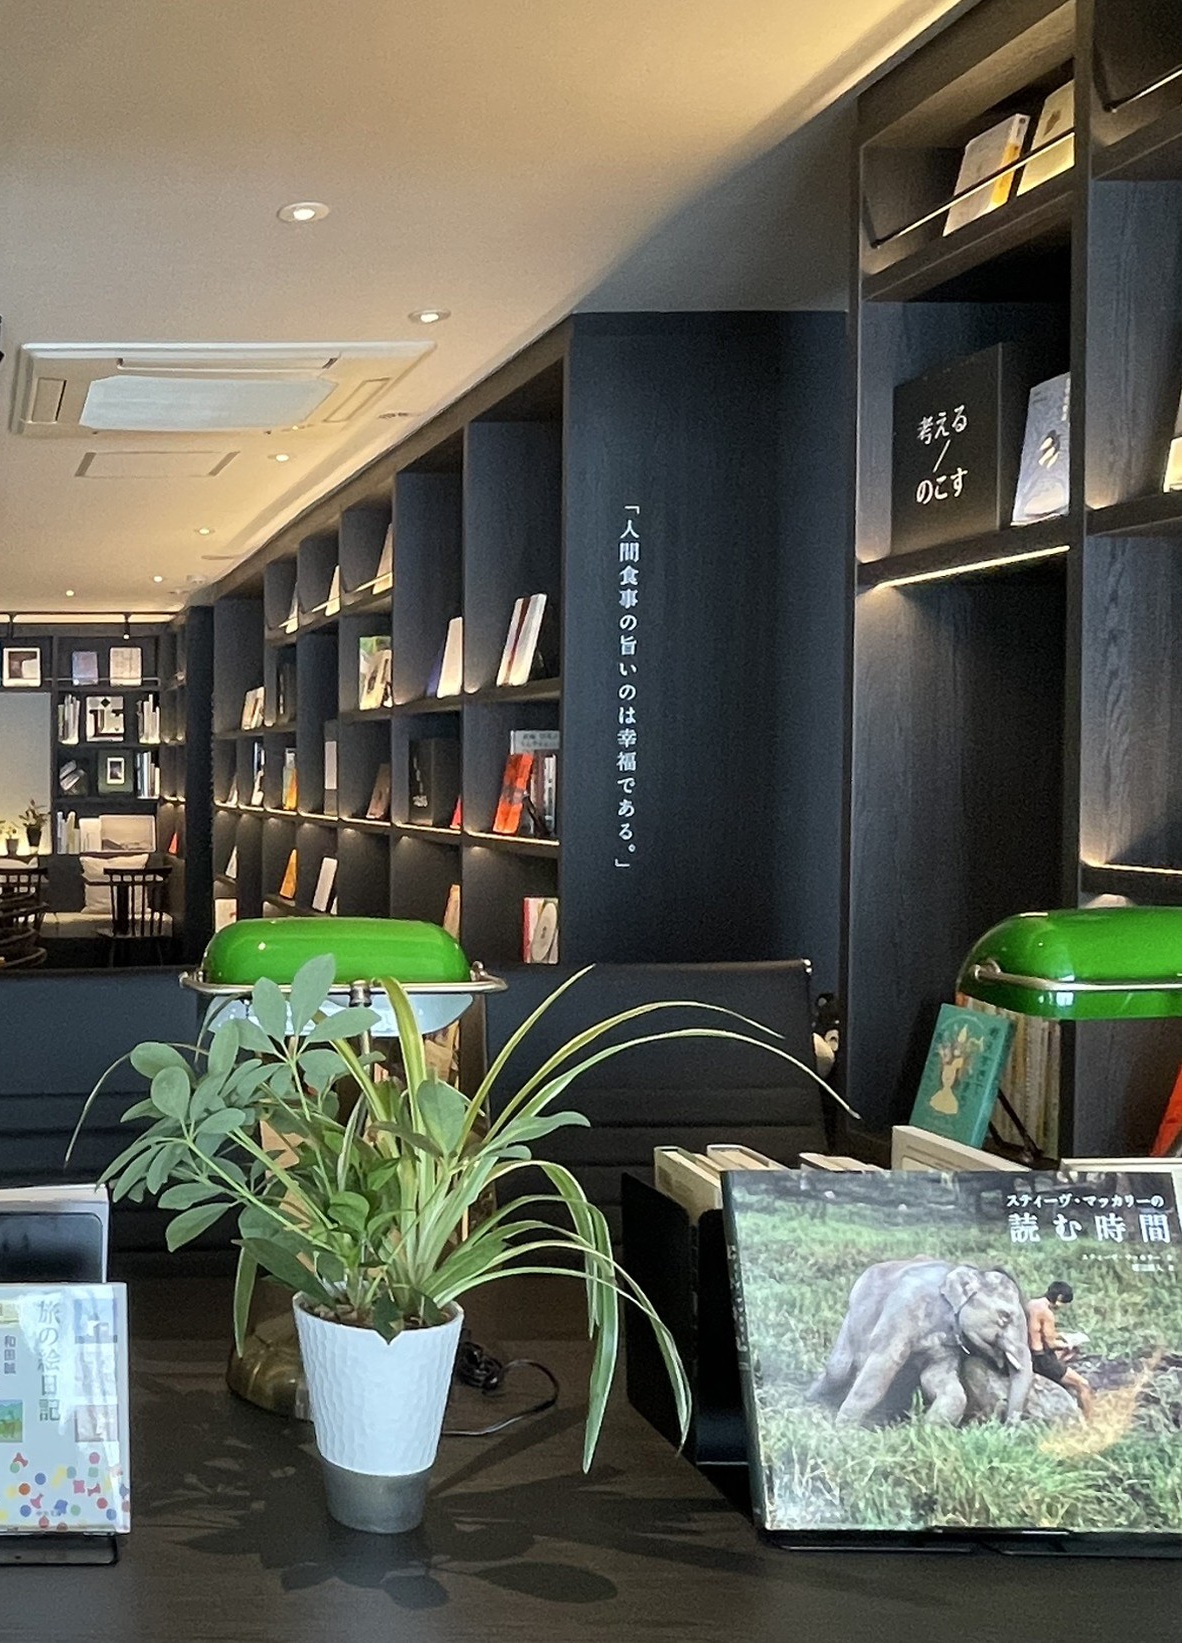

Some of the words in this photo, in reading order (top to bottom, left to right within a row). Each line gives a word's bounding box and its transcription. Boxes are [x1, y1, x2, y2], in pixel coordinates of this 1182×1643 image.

[916, 403, 968, 446] 考える
[915, 466, 969, 505] のこす
[615, 505, 641, 868] 「人間食事の旨いのは幸福である。」
[1005, 1192, 1166, 1209] スティーヴ・マッカリーの
[1007, 1211, 1172, 1244] 読む時間
[36, 1299, 62, 1422] 旅の絵日記
